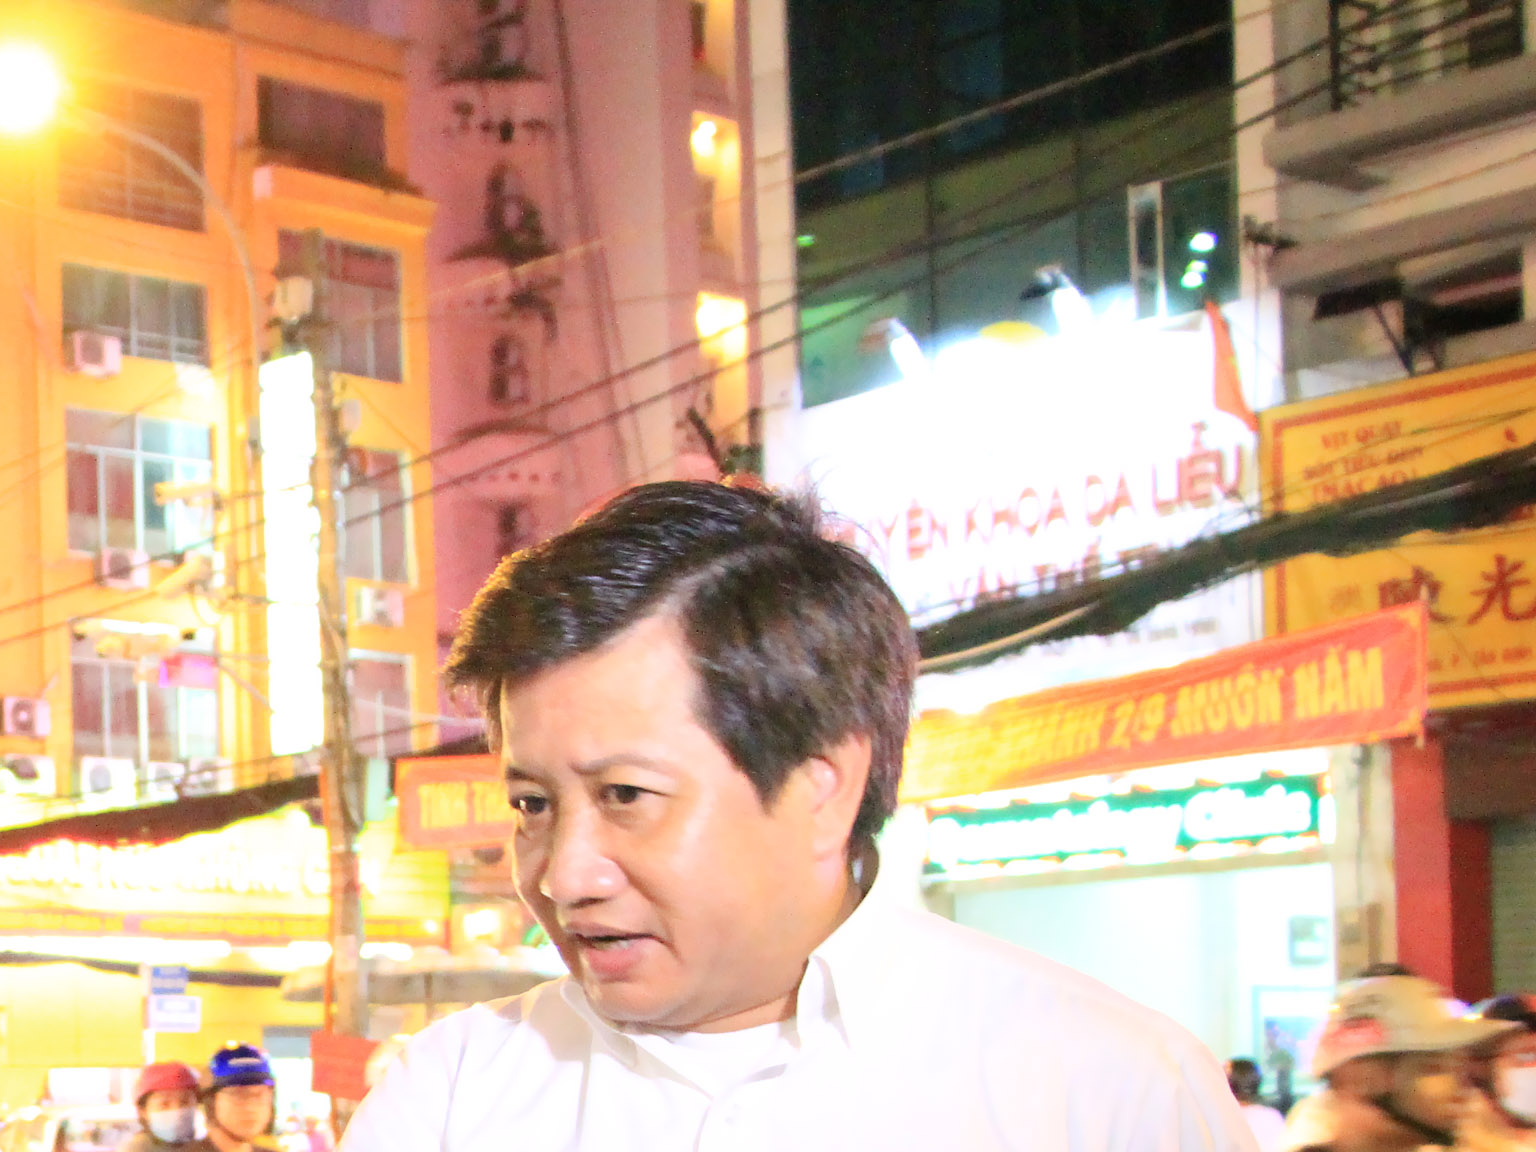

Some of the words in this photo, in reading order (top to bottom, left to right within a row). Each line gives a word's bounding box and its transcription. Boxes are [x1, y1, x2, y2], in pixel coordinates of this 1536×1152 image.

[965, 485, 1070, 545] KHOA
[1085, 472, 1137, 528] DA
[1170, 663, 1284, 737] MUÔN
[1294, 644, 1385, 720] NĂM
